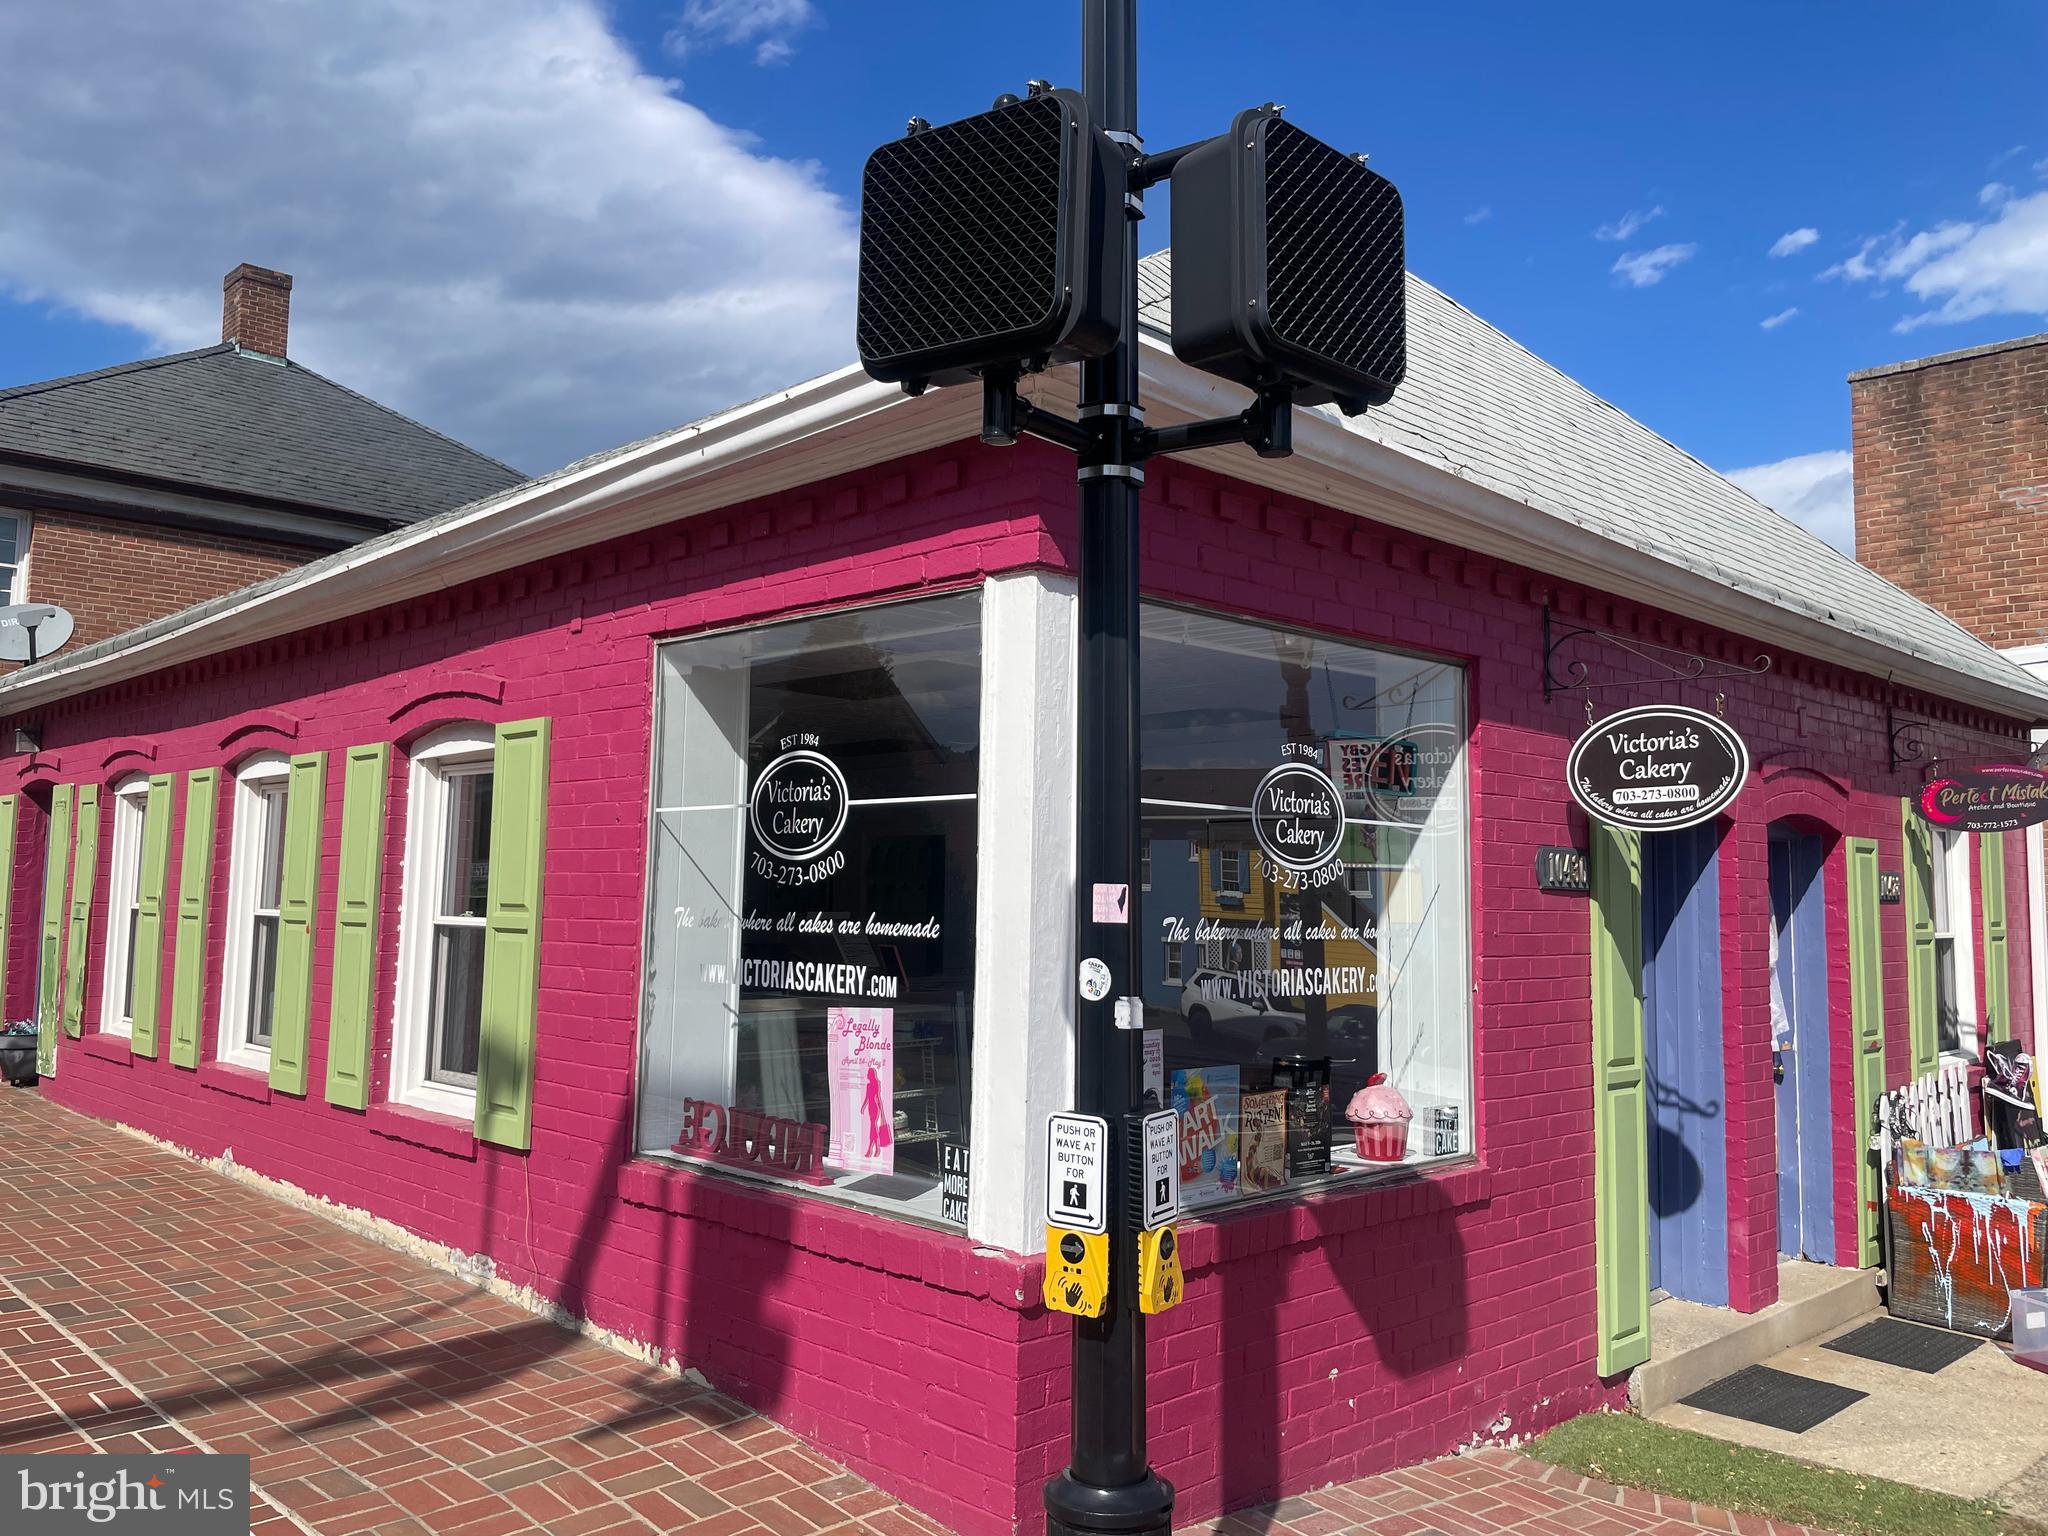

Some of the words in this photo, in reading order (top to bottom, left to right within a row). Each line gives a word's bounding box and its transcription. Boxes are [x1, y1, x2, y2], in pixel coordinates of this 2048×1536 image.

[780, 734, 798, 750] EST
[801, 733, 820, 747] 1984
[1281, 743, 1297, 756] EST
[1299, 743, 1318, 760] 1984
[1607, 727, 1699, 755] Victoria's
[1619, 755, 1692, 784] Cakery
[767, 776, 831, 803] Victoria's
[1268, 787, 1330, 816] Victoria's
[1589, 792, 1614, 812] bakery
[1615, 807, 1639, 818] where
[1640, 810, 1653, 819] all
[1655, 808, 1678, 819] cakes
[1680, 805, 1695, 814] are
[1696, 775, 1731, 809] homemade
[1615, 787, 1696, 802] 703-273-0800
[773, 807, 824, 842] Cakery
[1276, 817, 1325, 854] Cakery
[1967, 818, 2018, 830] 703-772-1573
[751, 850, 844, 886] 703-273-0800
[1253, 853, 1344, 890] 703-273-0800
[674, 906, 694, 928] The
[777, 911, 796, 932] all
[798, 911, 834, 934] cakes
[838, 918, 861, 935] are
[865, 912, 941, 939] homemade
[1162, 917, 1190, 942] The
[1195, 918, 1240, 947] bakery
[1243, 918, 1280, 940] where
[1283, 920, 1303, 940] all
[1305, 919, 1337, 940] cakes
[1341, 926, 1360, 940] are
[842, 1017, 881, 1037] Legally
[854, 1036, 892, 1055] Blonde
[1150, 1123, 1164, 1136] PUSH
[1165, 1120, 1173, 1131] OR
[1182, 1094, 1218, 1138] ART
[1057, 1124, 1080, 1136] PUSH
[1084, 1127, 1096, 1138] OR
[1150, 1136, 1165, 1149] WAVE
[1166, 1134, 1173, 1145] AT
[1179, 1111, 1235, 1167] WALK
[1435, 1132, 1458, 1154] CAKE
[1056, 1137, 1080, 1150] WAVE
[1084, 1141, 1096, 1152] AT
[944, 1146, 969, 1173] EAT
[1058, 1152, 1094, 1166] BUTTON
[1151, 1150, 1173, 1164] BUTTON
[1066, 1168, 1084, 1179] FOR
[1156, 1164, 1168, 1175] FOR
[943, 1173, 968, 1197] MORE
[943, 1198, 967, 1223] CAKE
